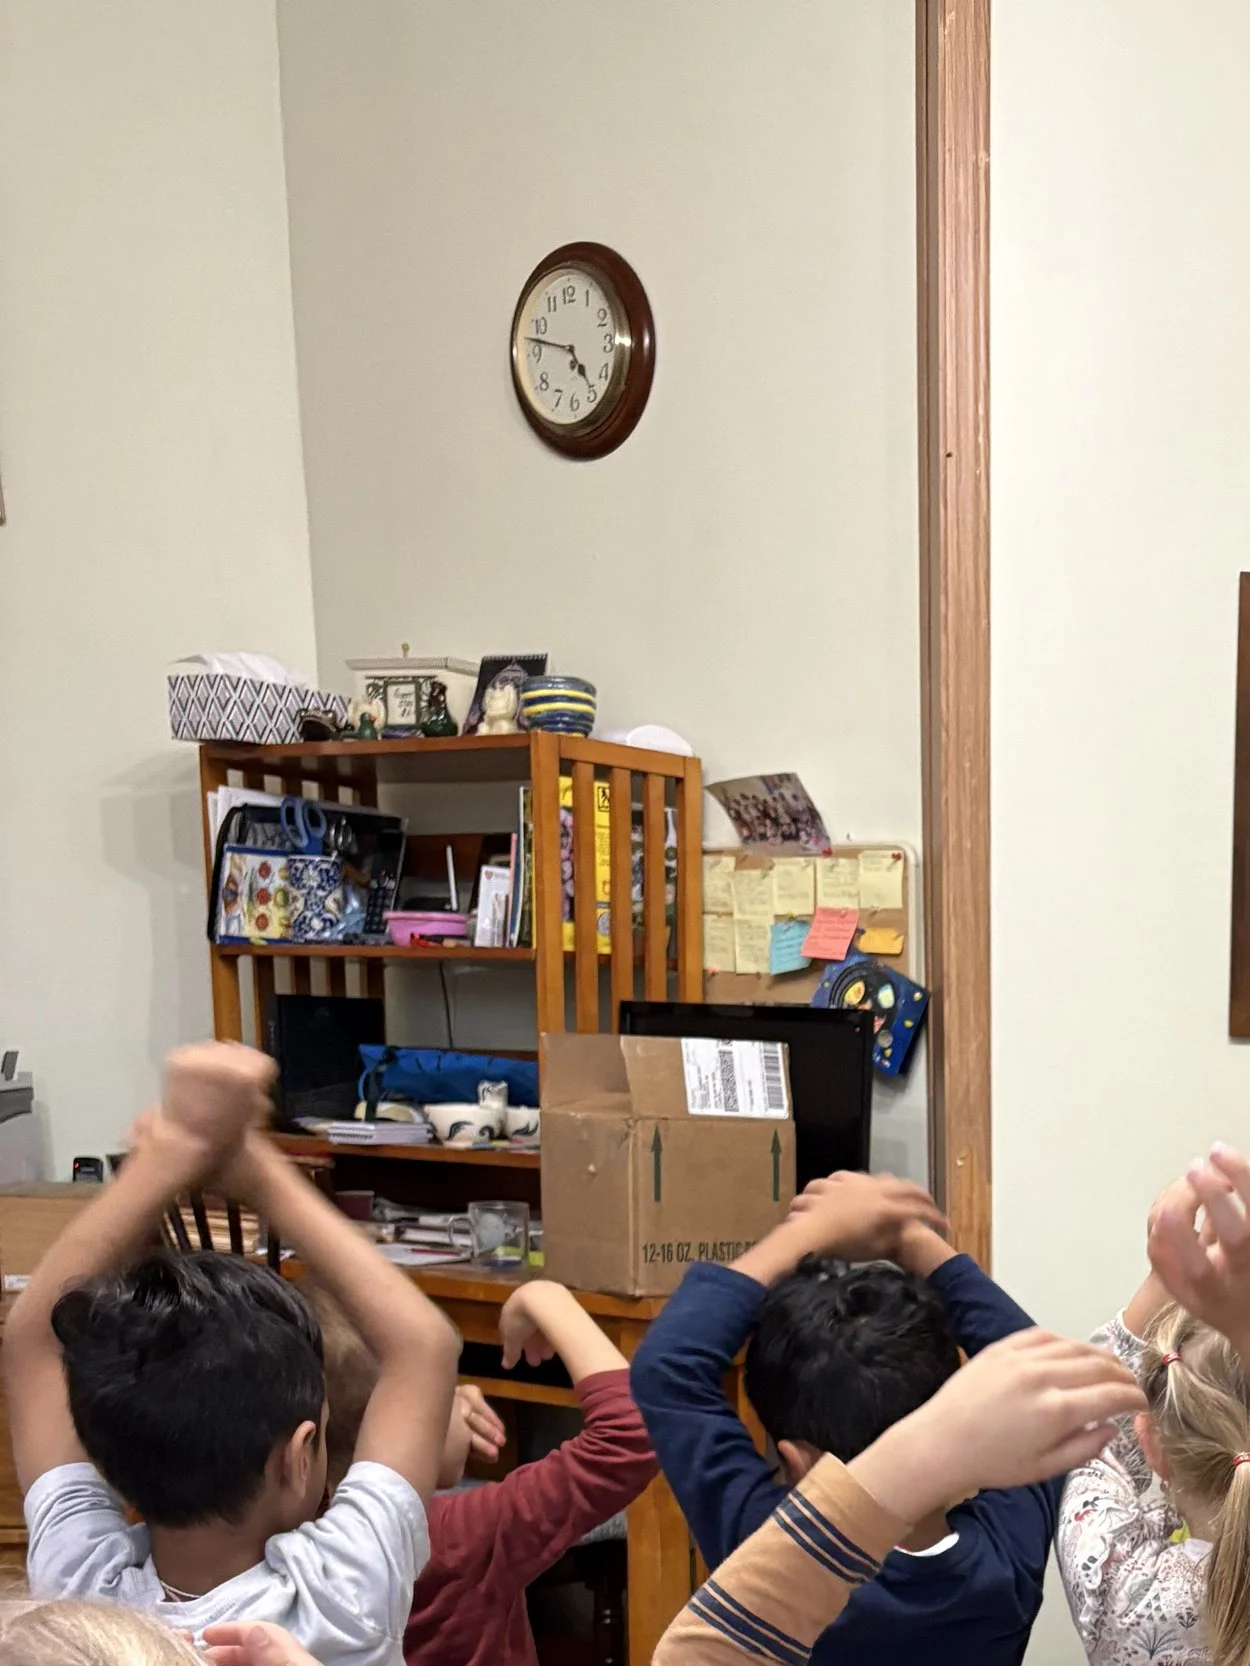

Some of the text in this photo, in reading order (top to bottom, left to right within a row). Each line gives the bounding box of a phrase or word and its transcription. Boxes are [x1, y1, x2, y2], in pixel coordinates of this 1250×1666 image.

[547, 295, 557, 313] 11
[562, 285, 576, 305] 12
[534, 316, 547, 335] 10
[597, 308, 607, 328] 2
[603, 333, 613, 353] 3
[532, 344, 542, 363] 9
[539, 371, 549, 391] 8
[599, 363, 609, 381] 4
[553, 388, 563, 408] 7
[569, 391, 580, 412] 6
[586, 384, 597, 403] 5
[642, 1242, 673, 1262] 12-16
